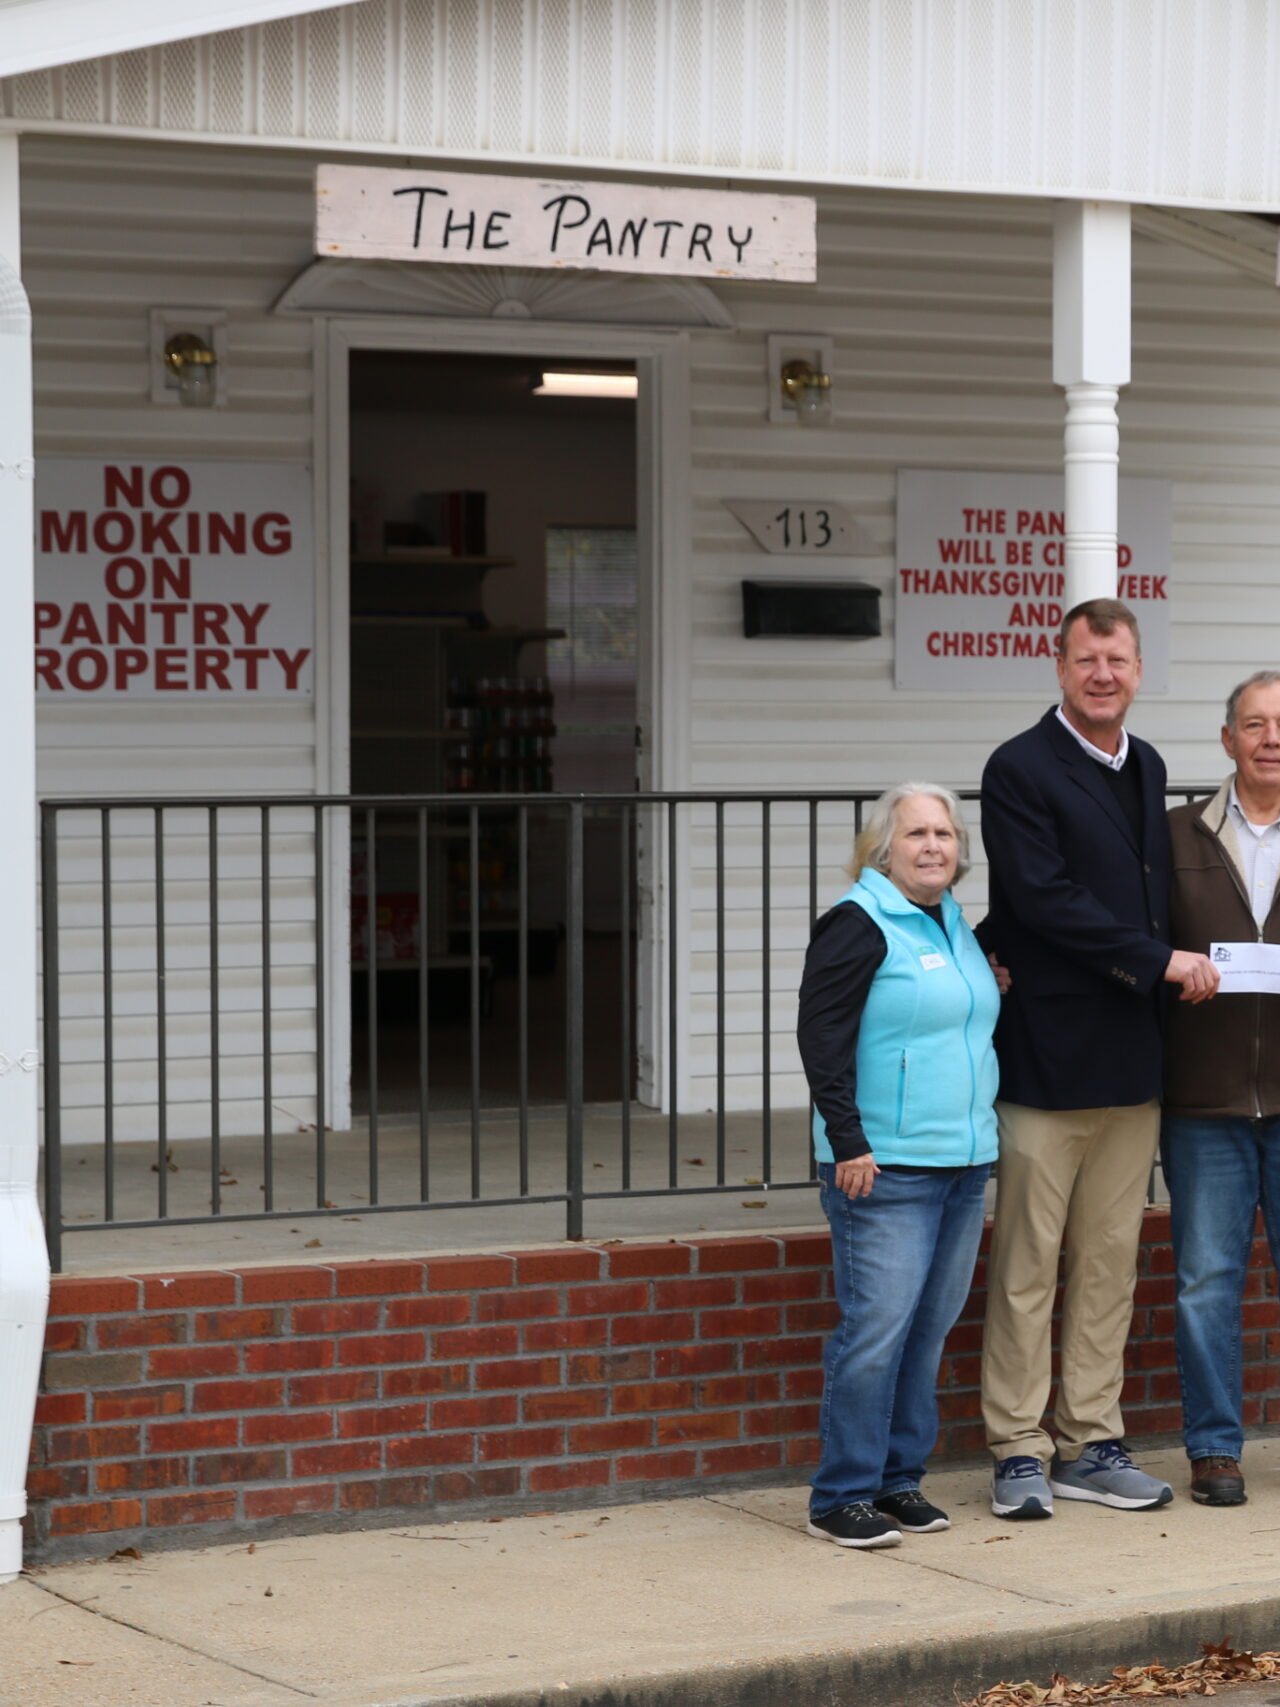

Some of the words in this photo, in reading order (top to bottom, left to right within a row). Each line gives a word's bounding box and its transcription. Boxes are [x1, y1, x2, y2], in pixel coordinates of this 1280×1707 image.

[393, 187, 511, 250] THE
[543, 195, 752, 263] PANTRY
[103, 465, 191, 509] NO
[40, 510, 293, 555] MOKING
[775, 508, 832, 549] 113
[962, 508, 1006, 534] THE
[1016, 509, 1065, 536] PAN
[938, 538, 996, 564] WILL
[1006, 540, 1033, 566] BE
[104, 556, 191, 600] ON
[899, 568, 1065, 597] THANKSGIVI
[1117, 575, 1168, 599] EEK
[34, 602, 271, 645] PANTRY
[1008, 602, 1063, 628] AND
[34, 648, 312, 691] ROPERTY
